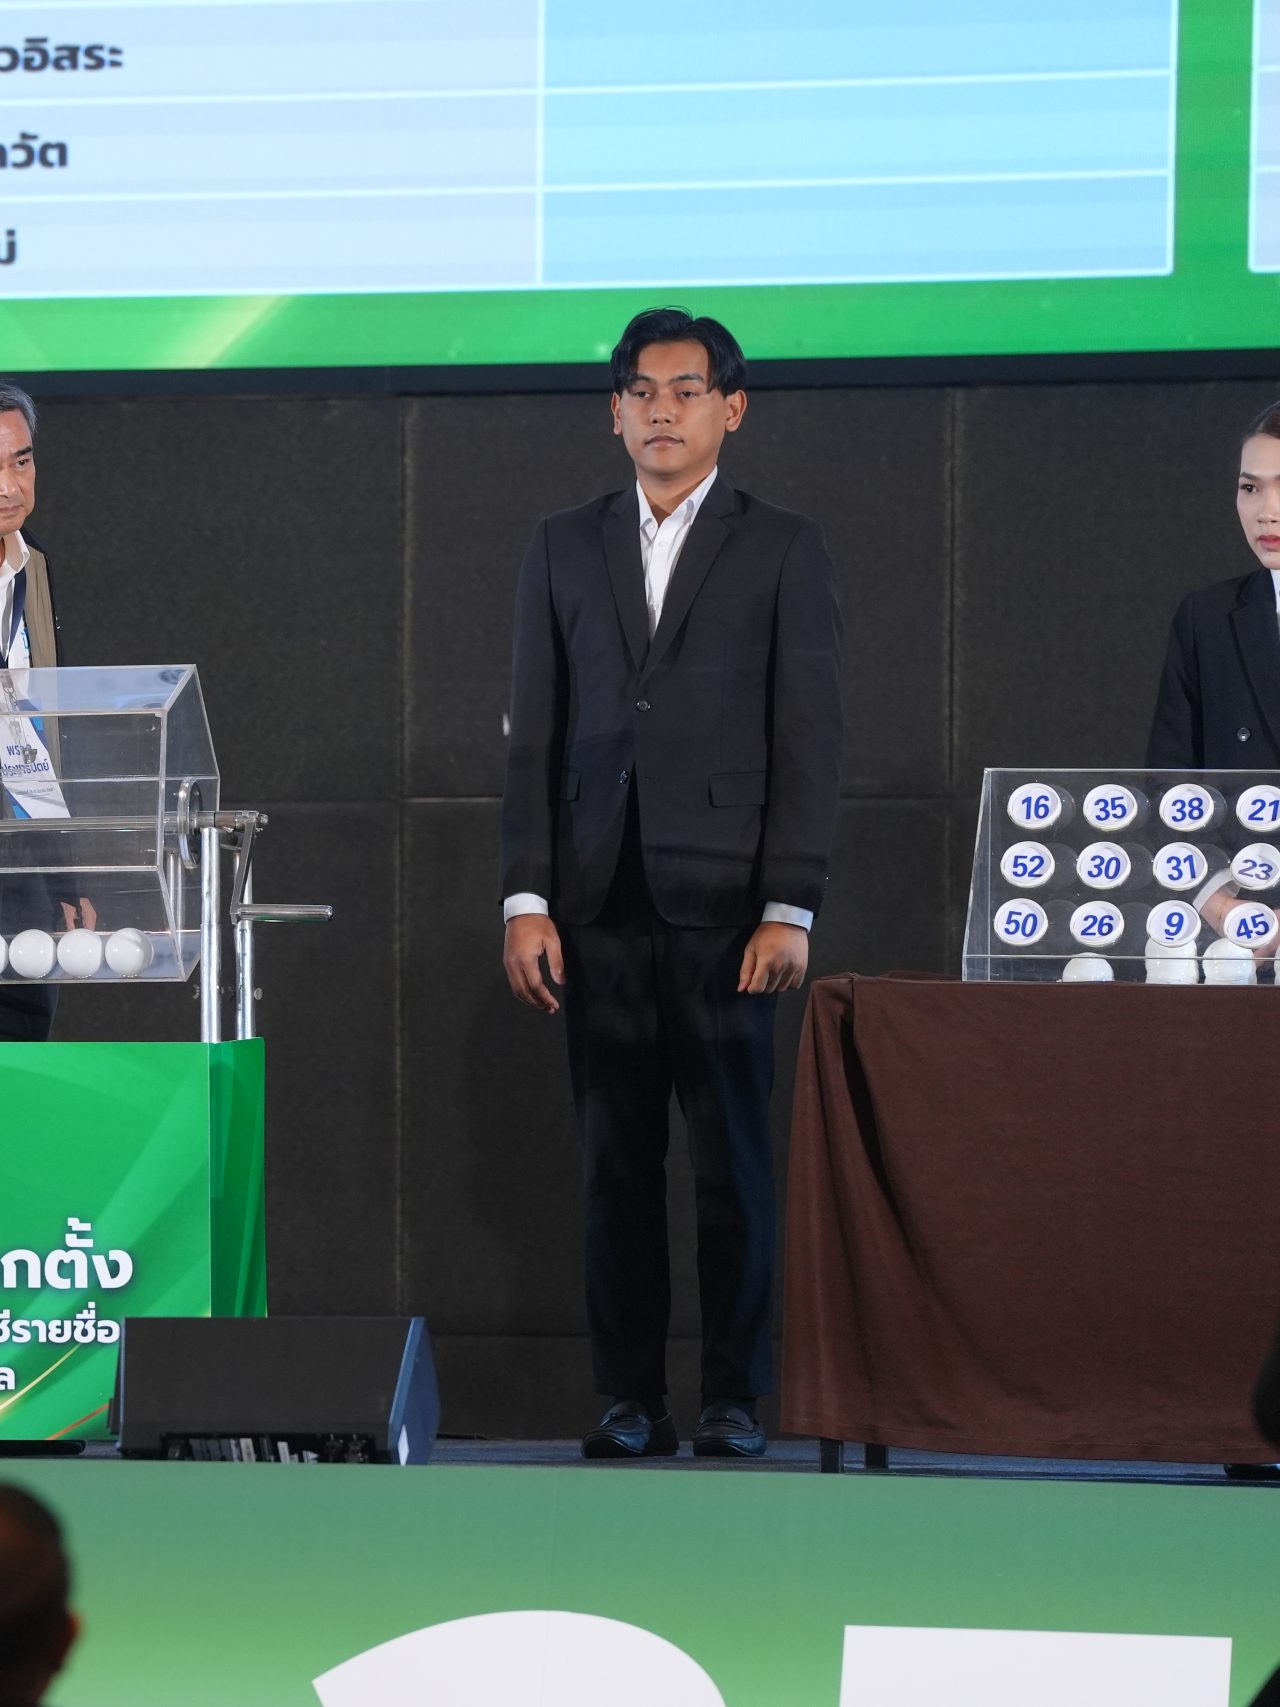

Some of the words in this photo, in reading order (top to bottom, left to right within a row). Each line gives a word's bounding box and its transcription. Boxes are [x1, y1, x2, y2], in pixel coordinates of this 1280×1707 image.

[1021, 795, 1050, 820] 16
[1093, 796, 1128, 822] 35
[1170, 796, 1205, 823] 38
[1247, 798, 1280, 822] 21
[1011, 855, 1045, 878] 52
[1087, 855, 1121, 880] 30
[1166, 854, 1197, 881] 31
[1238, 859, 1273, 881] 23
[1003, 911, 1039, 938] 50
[1080, 914, 1115, 937] 26
[1163, 911, 1185, 941] 9
[1235, 912, 1271, 940] 45
